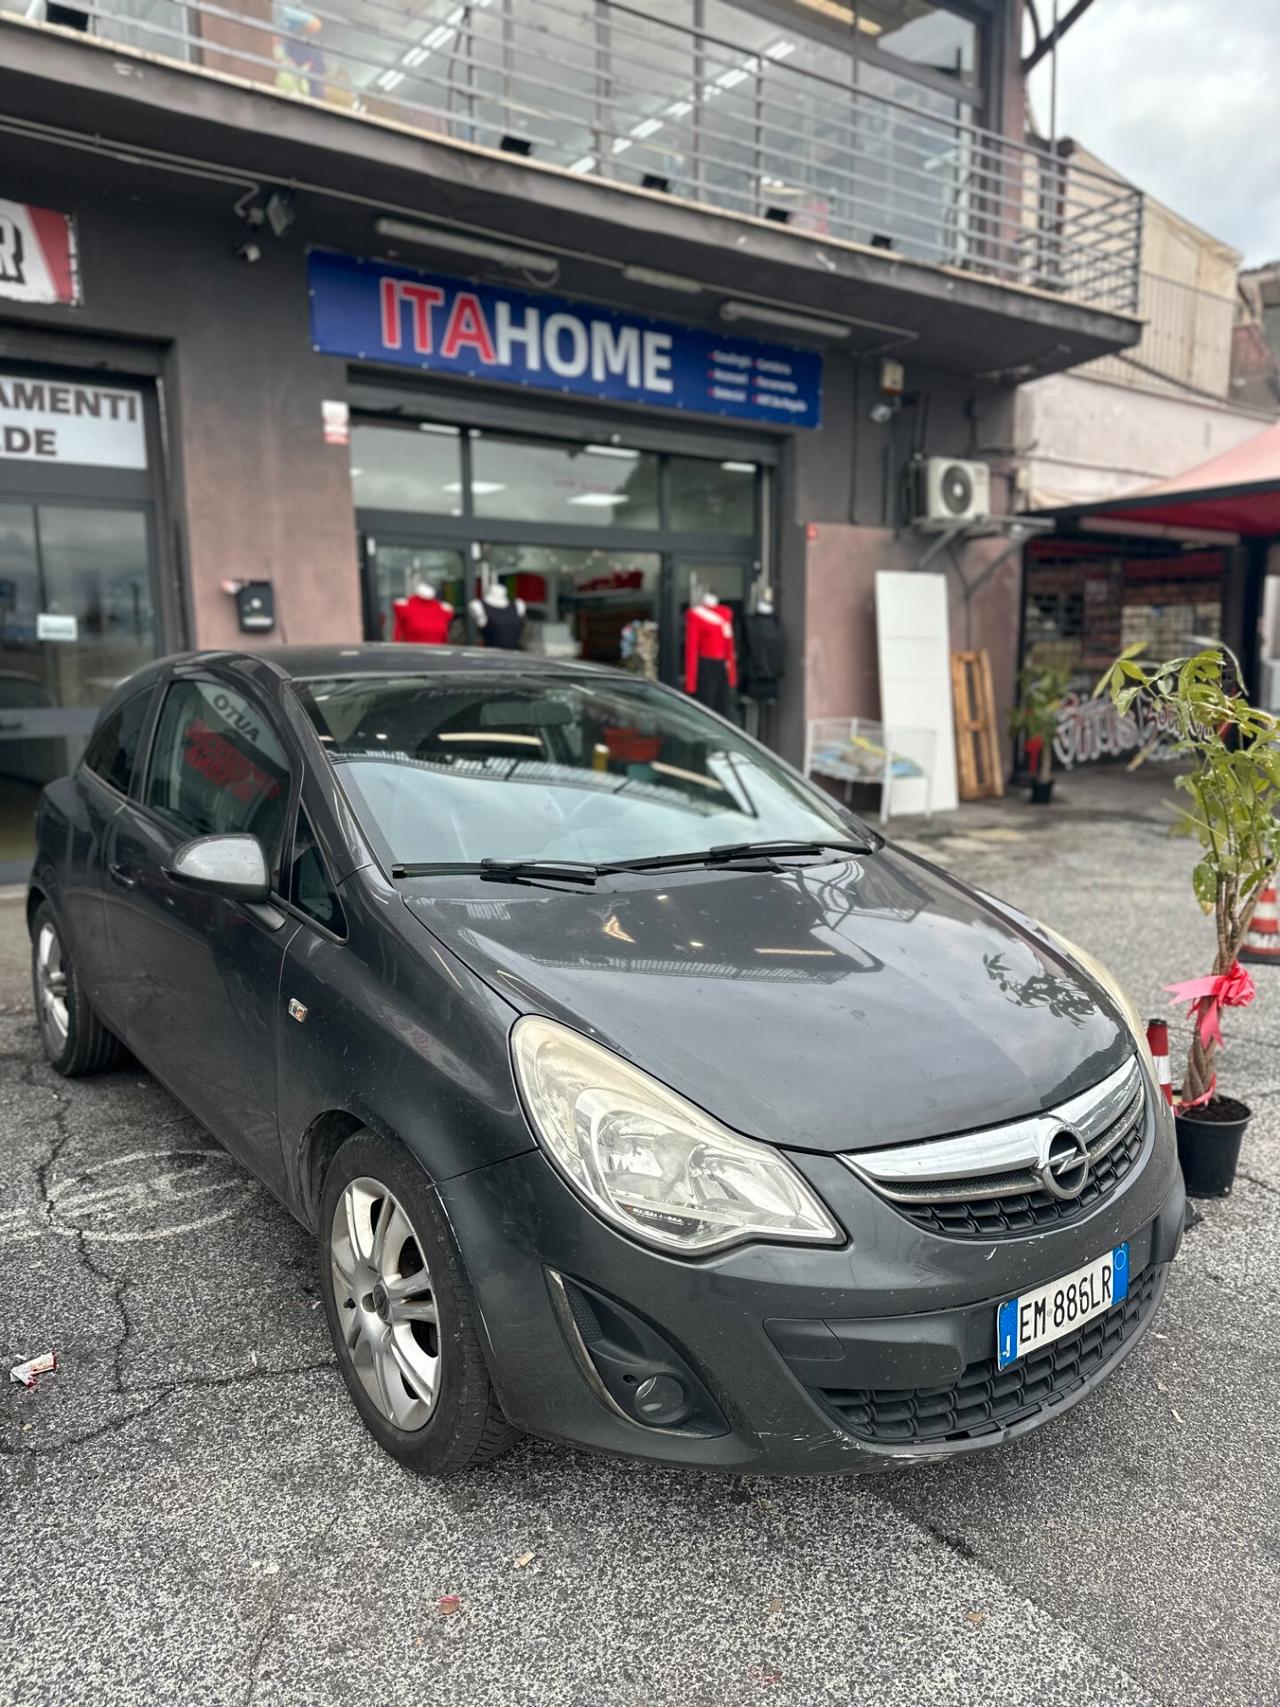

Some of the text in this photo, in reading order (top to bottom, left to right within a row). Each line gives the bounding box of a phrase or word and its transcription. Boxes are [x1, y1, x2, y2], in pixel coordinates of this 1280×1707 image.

[379, 277, 674, 393] ITAHOME
[0, 426, 56, 456] DE
[1020, 1297, 1046, 1344] EM
